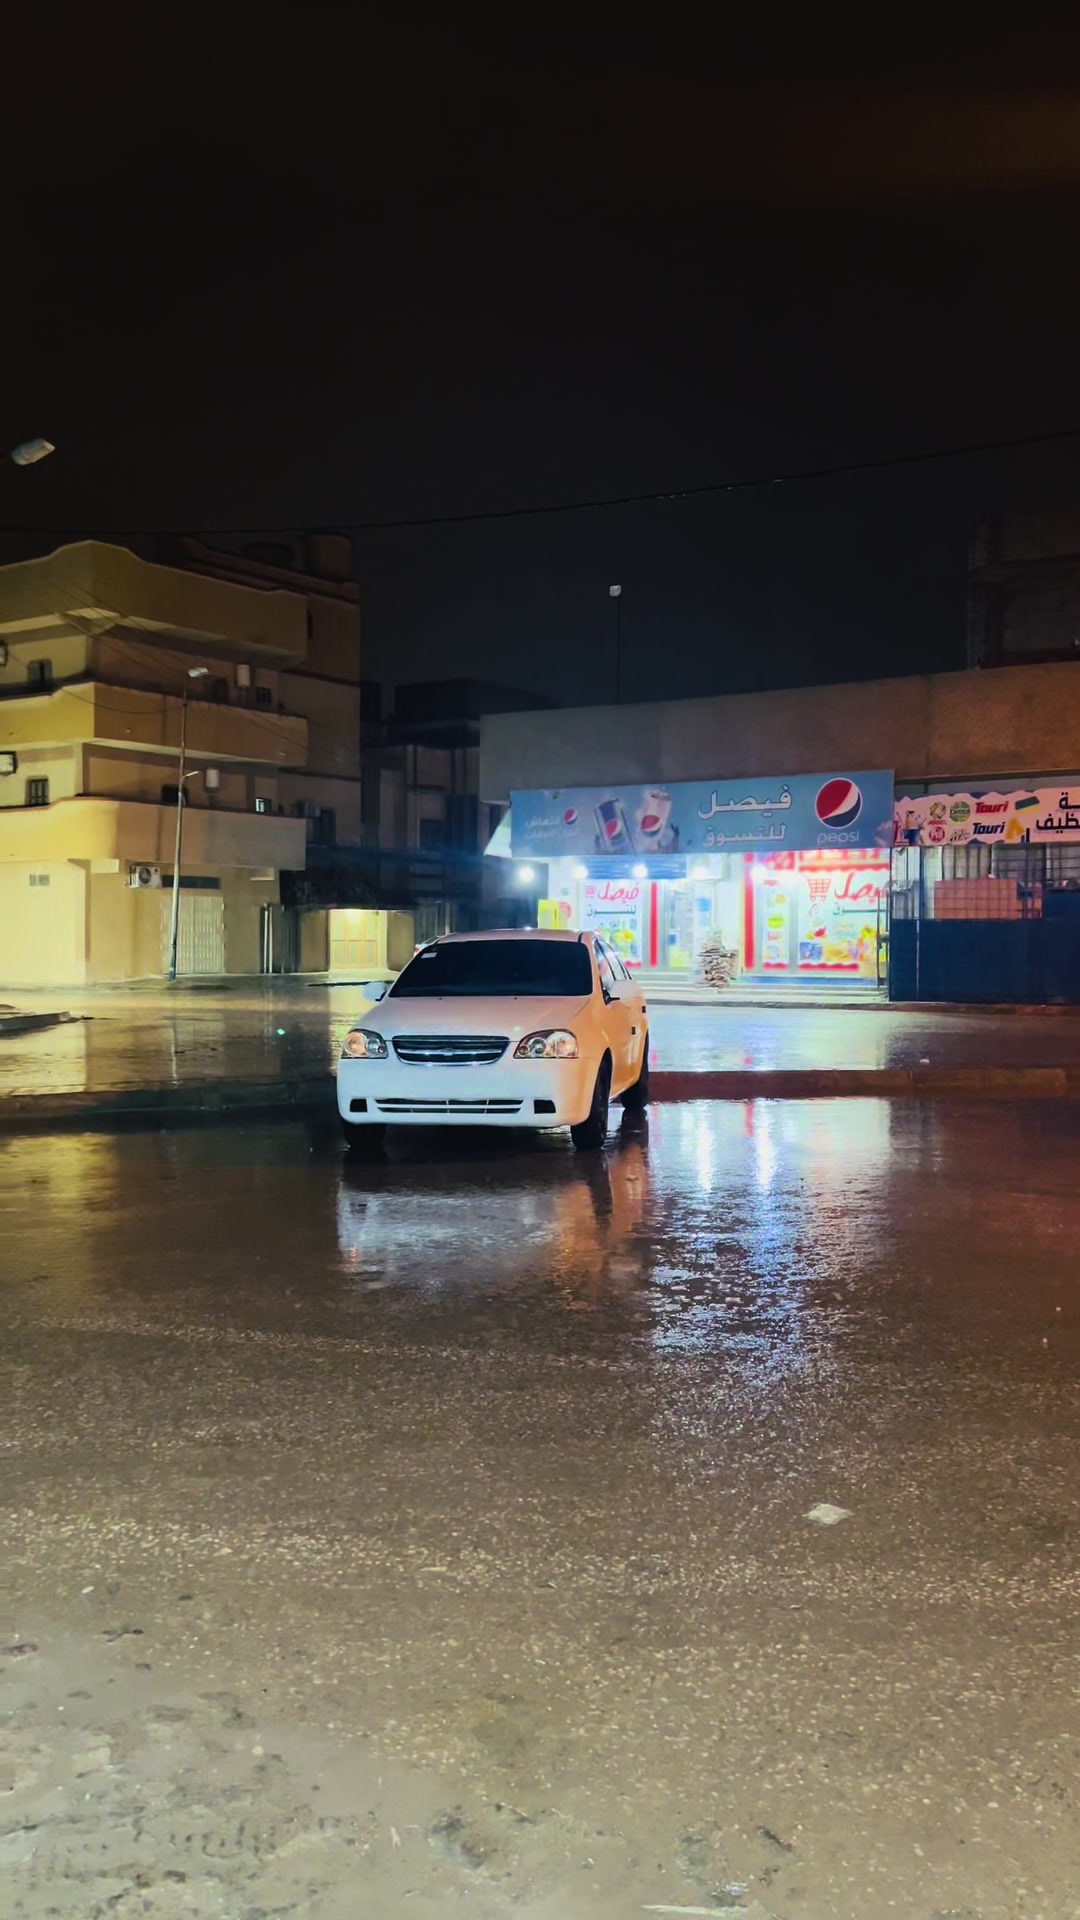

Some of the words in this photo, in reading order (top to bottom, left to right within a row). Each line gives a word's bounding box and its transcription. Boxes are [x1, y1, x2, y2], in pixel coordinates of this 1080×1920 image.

[698, 784, 792, 819] فيصل
[975, 801, 1009, 814] Touri
[703, 823, 787, 847] للتسوق
[972, 822, 1006, 835] Touri
[817, 830, 860, 844] pepsi
